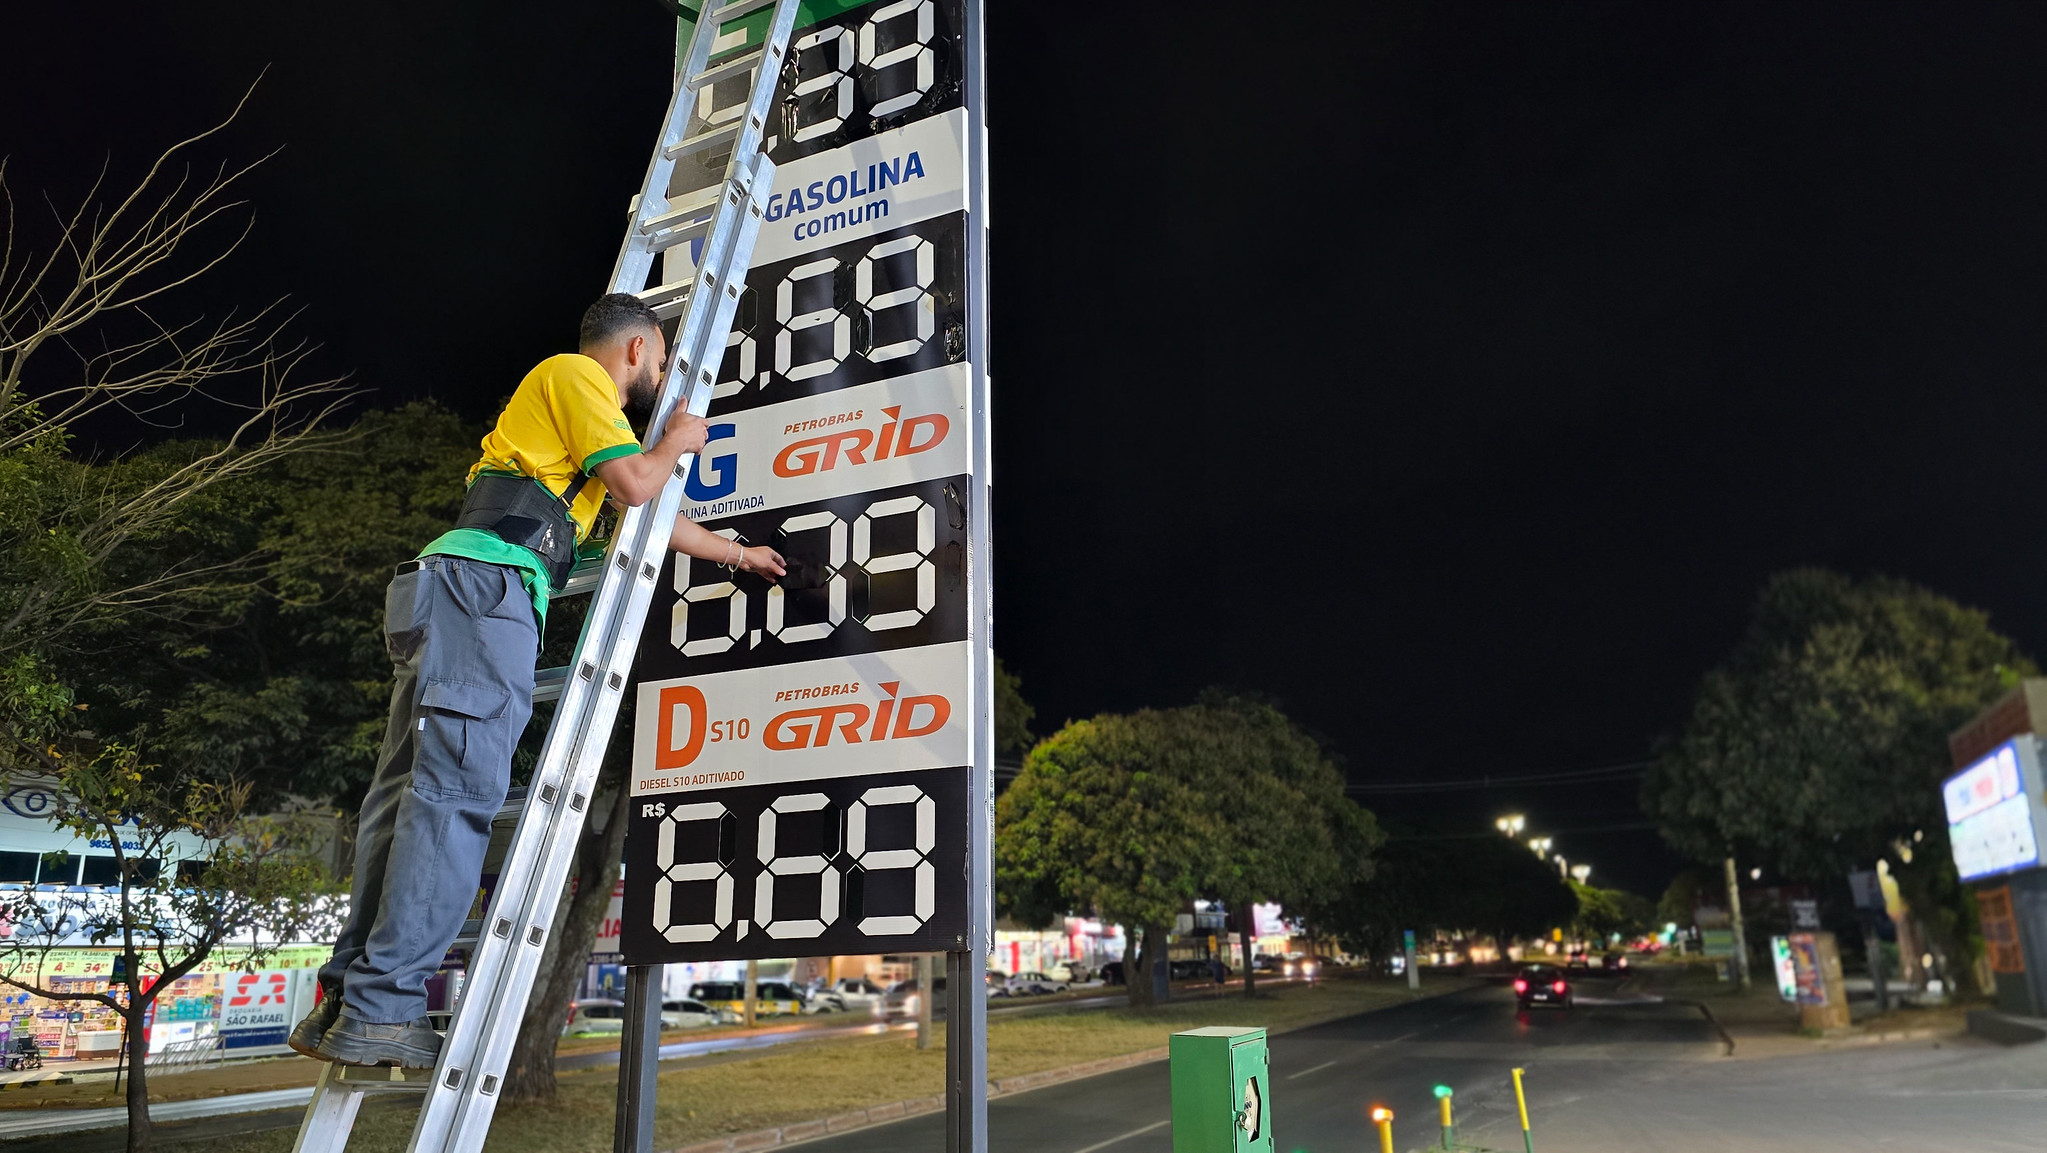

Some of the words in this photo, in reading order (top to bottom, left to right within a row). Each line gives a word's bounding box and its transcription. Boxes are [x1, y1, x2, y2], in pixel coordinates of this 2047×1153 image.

[765, 150, 926, 223] GASOLINA
[793, 198, 890, 242] comum
[783, 409, 864, 435] PETROBRAS
[772, 405, 950, 478] GRID
[711, 495, 765, 516] ADITIVADA
[775, 681, 860, 703] PETROBRAS
[655, 685, 708, 771] D
[710, 717, 750, 743] S10
[762, 681, 952, 751] GRID
[640, 775, 672, 790] DIESEL
[673, 774, 691, 788] S10
[692, 770, 746, 786] ADITIVADO
[641, 802, 667, 818] R$
[652, 784, 936, 943] 6,69
[225, 1013, 248, 1027] SÃO
[249, 1013, 284, 1026] RAFAEL
